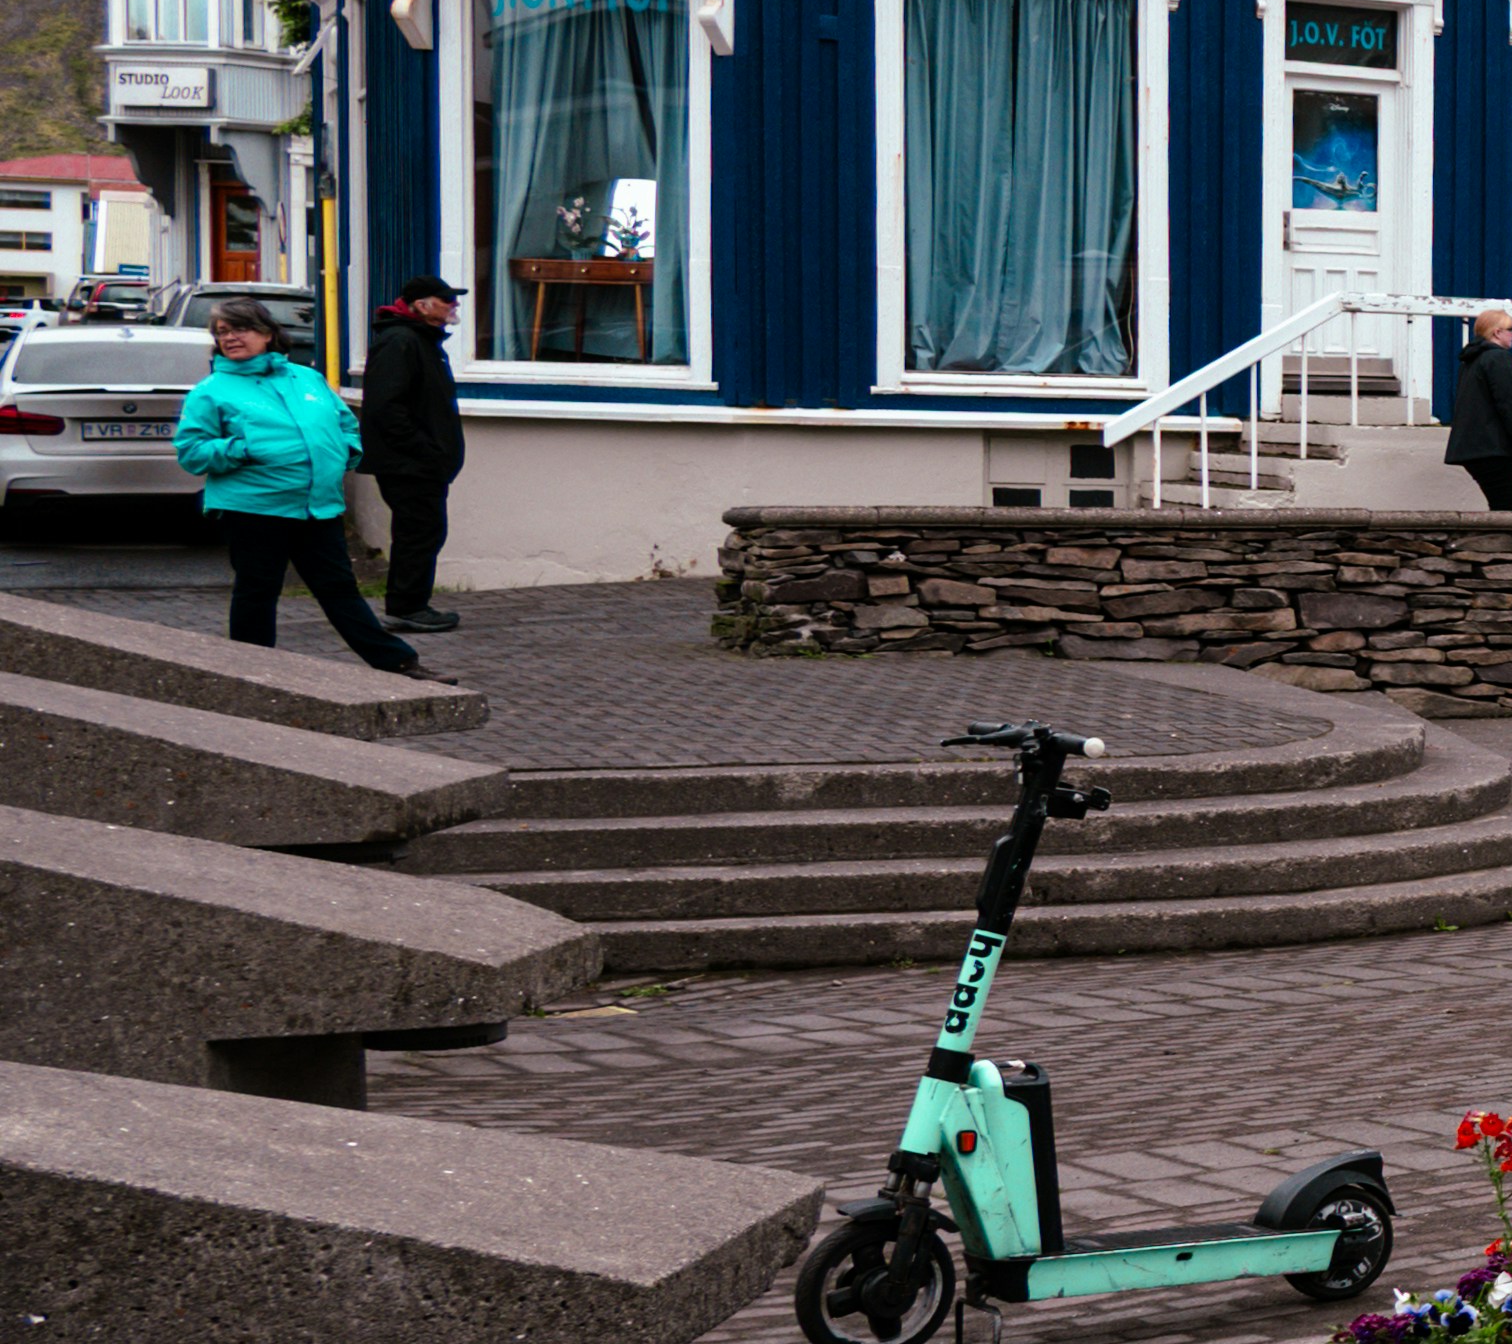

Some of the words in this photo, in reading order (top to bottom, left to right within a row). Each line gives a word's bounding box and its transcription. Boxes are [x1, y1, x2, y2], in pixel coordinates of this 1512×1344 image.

[1290, 19, 1345, 48] J.O.V.
[1351, 20, 1387, 51] FÖT
[119, 73, 170, 86] STUDIO
[161, 85, 204, 101] LOOK
